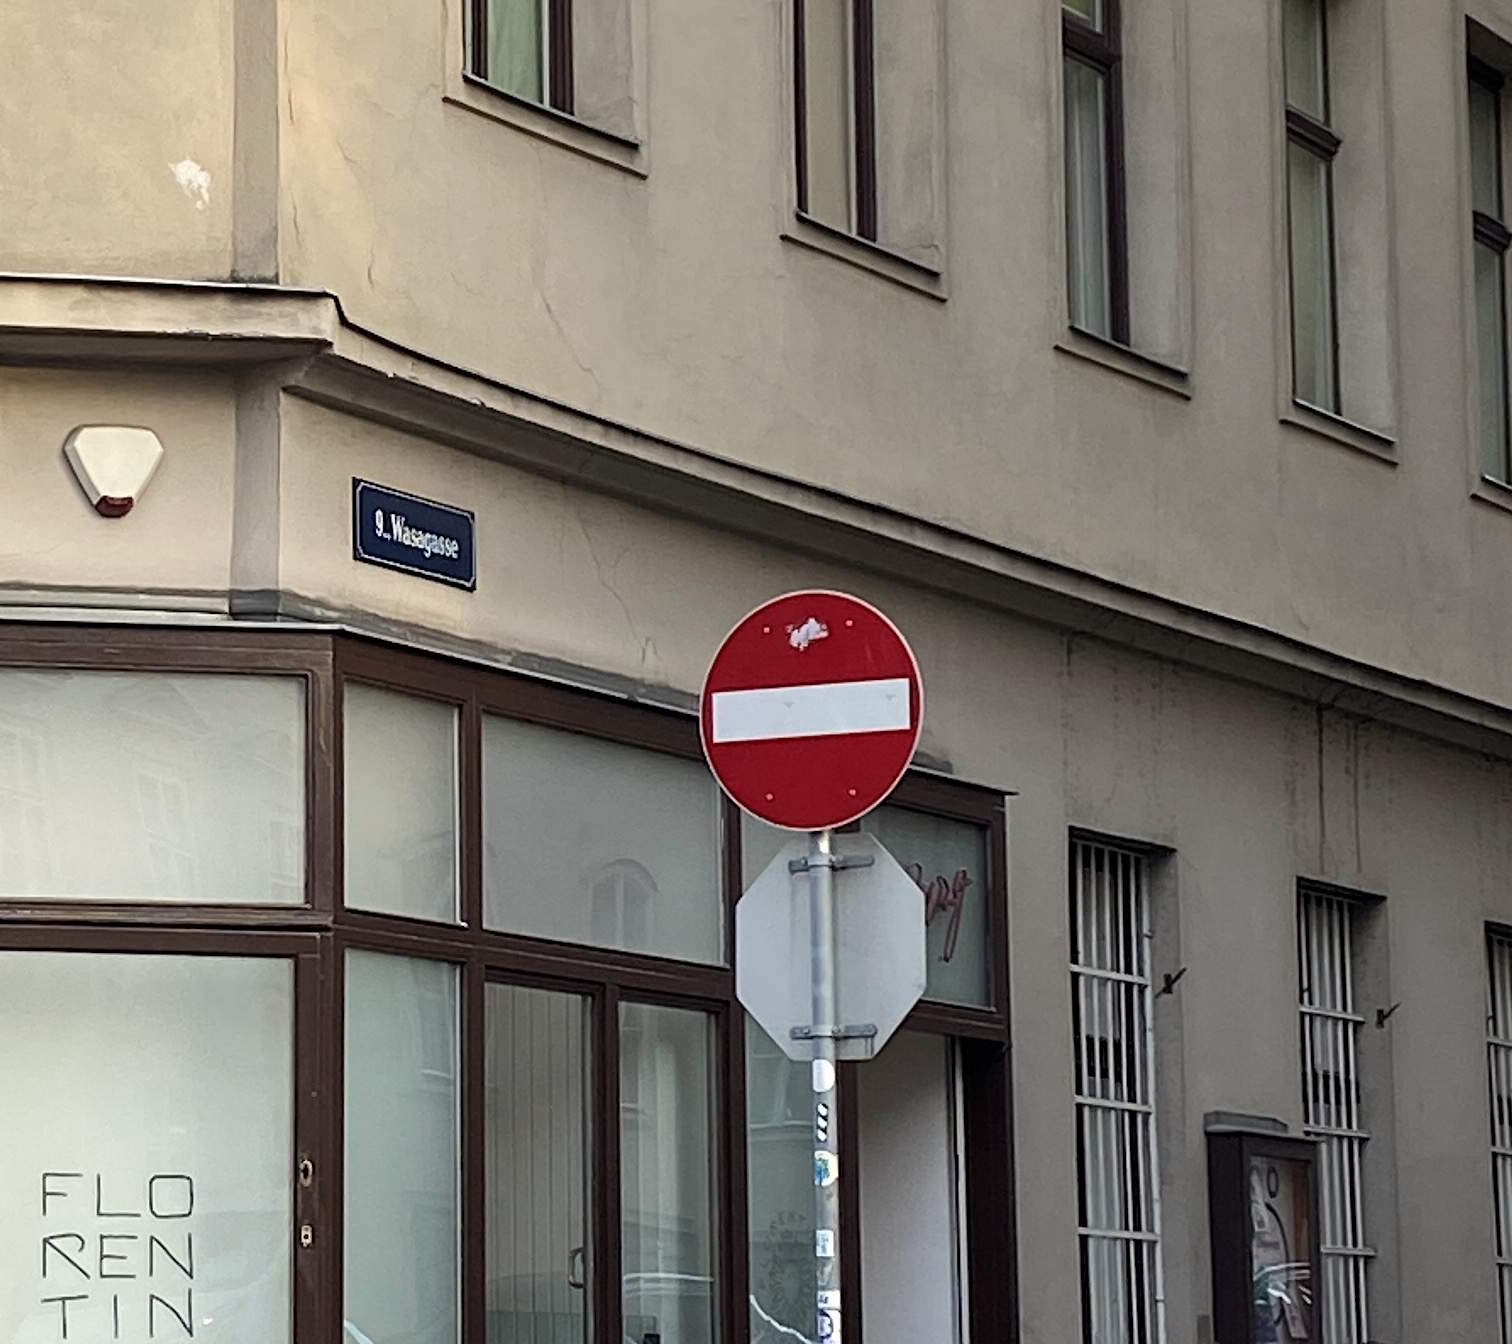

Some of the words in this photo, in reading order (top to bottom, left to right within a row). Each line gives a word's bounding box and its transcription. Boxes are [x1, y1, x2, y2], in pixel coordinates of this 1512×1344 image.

[41, 1172, 194, 1219] FLO
[42, 1231, 194, 1279] REN
[40, 1287, 194, 1340] TIN
